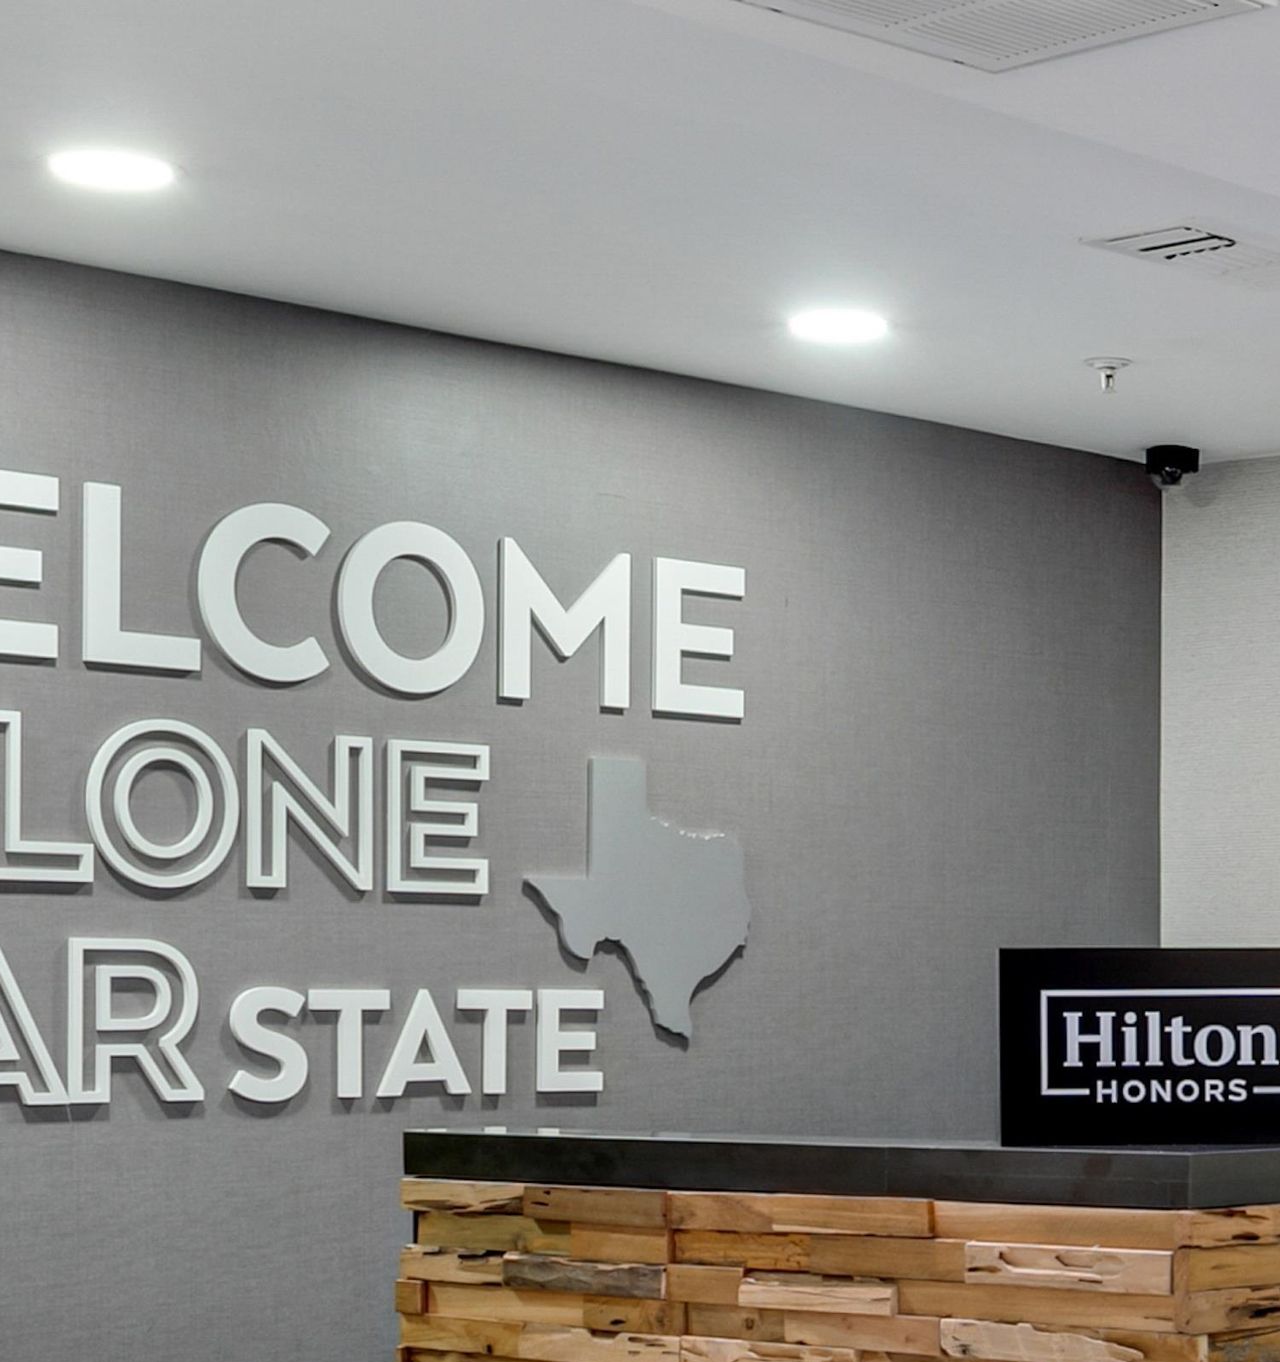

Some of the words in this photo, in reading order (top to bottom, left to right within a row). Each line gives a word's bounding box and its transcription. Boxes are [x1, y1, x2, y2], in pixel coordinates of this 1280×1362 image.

[227, 985, 604, 1102] STATE
[1063, 1011, 1280, 1067] Hilton
[1096, 1078, 1247, 1103] HONORS
